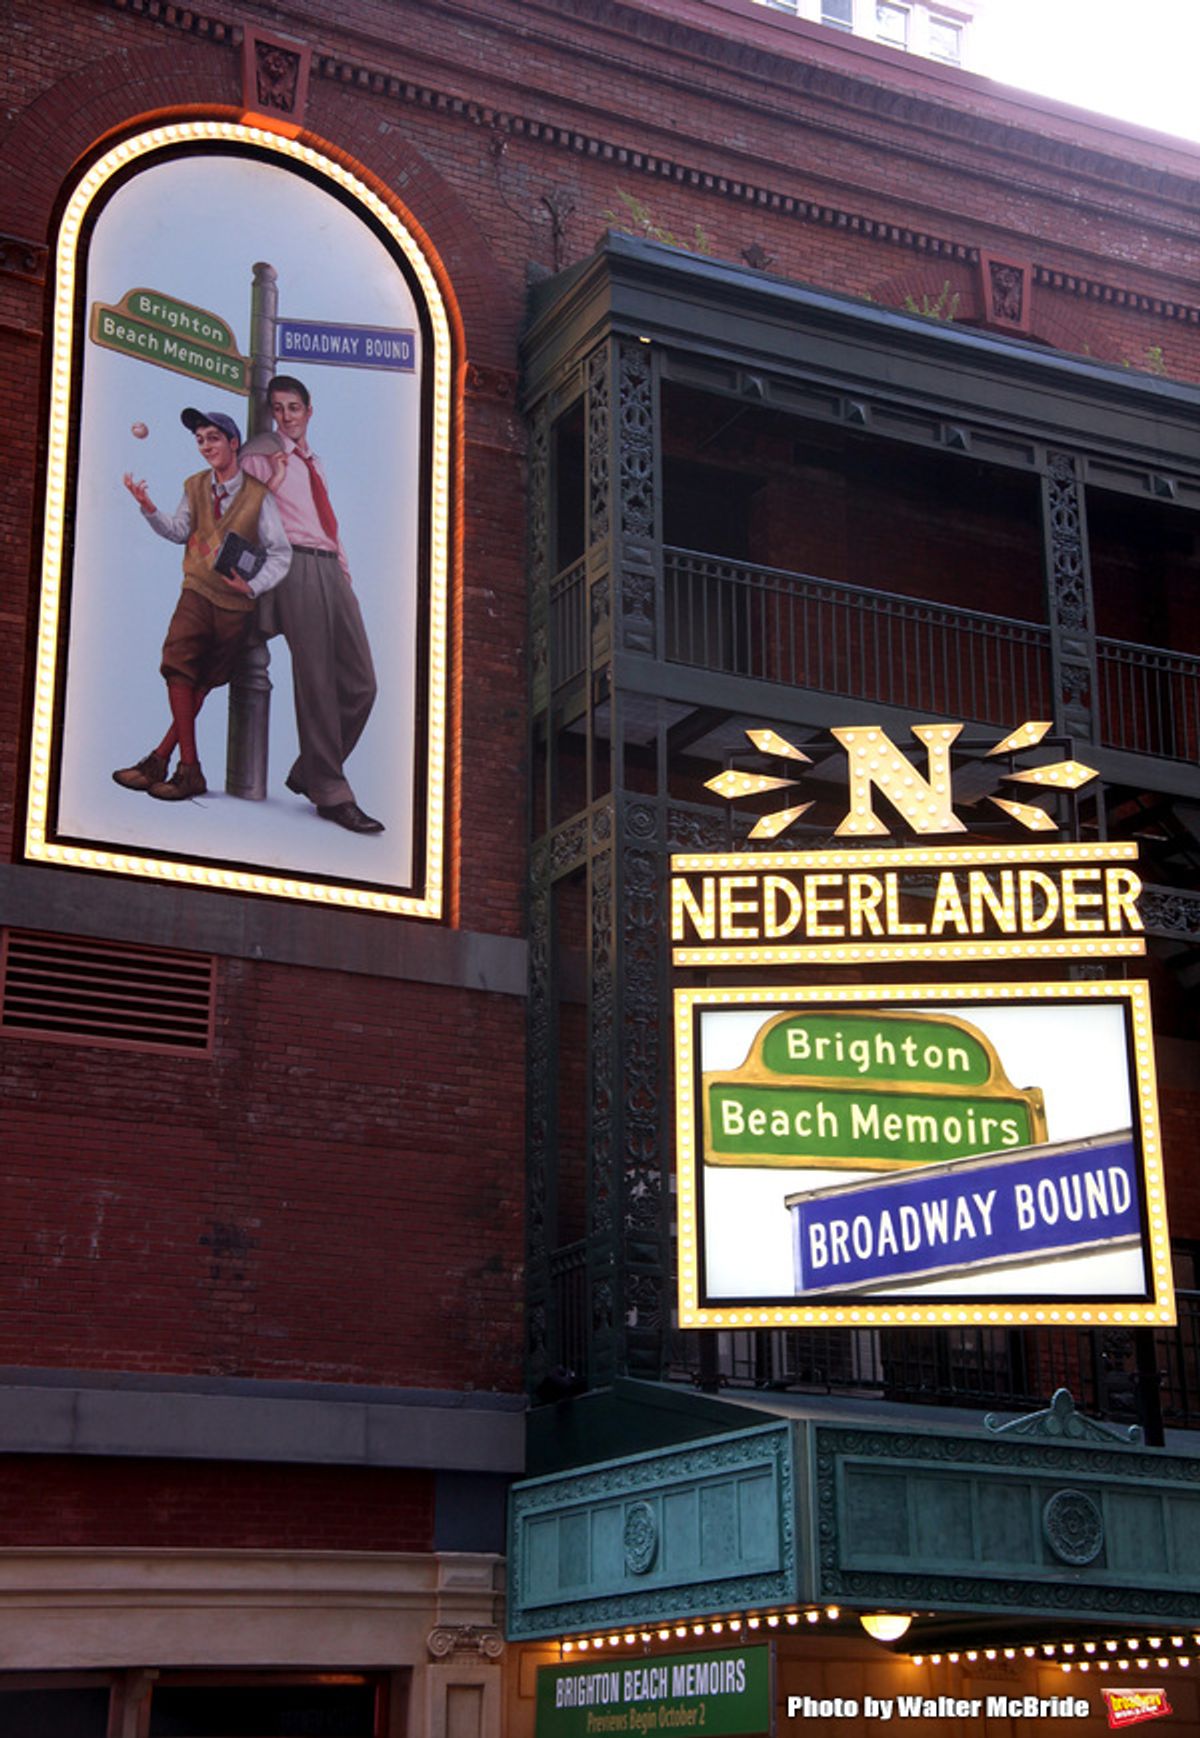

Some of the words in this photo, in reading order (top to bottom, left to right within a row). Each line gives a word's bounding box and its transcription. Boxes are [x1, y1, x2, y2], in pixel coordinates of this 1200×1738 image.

[139, 296, 223, 342] Brighton
[103, 317, 159, 350] Beach
[164, 338, 239, 379] Memoirs
[285, 332, 359, 354] BROADWAY
[366, 339, 409, 360] BOUND
[830, 724, 968, 835] N
[671, 868, 1144, 940] NEDERLANDER
[786, 1029, 970, 1073] Brighton
[721, 1100, 838, 1138] Beach
[851, 1104, 1020, 1145] Memoirs
[809, 1190, 997, 1269] BROADWAY
[1014, 1166, 1131, 1230] BOUND
[556, 1672, 620, 1708] BRIGHTON
[623, 1667, 668, 1702] BEACH
[672, 1658, 746, 1697] MEMOIRS
[587, 1711, 627, 1733] Previews
[629, 1707, 656, 1735] Begin
[658, 1703, 697, 1729] October
[699, 1702, 706, 1726] 2
